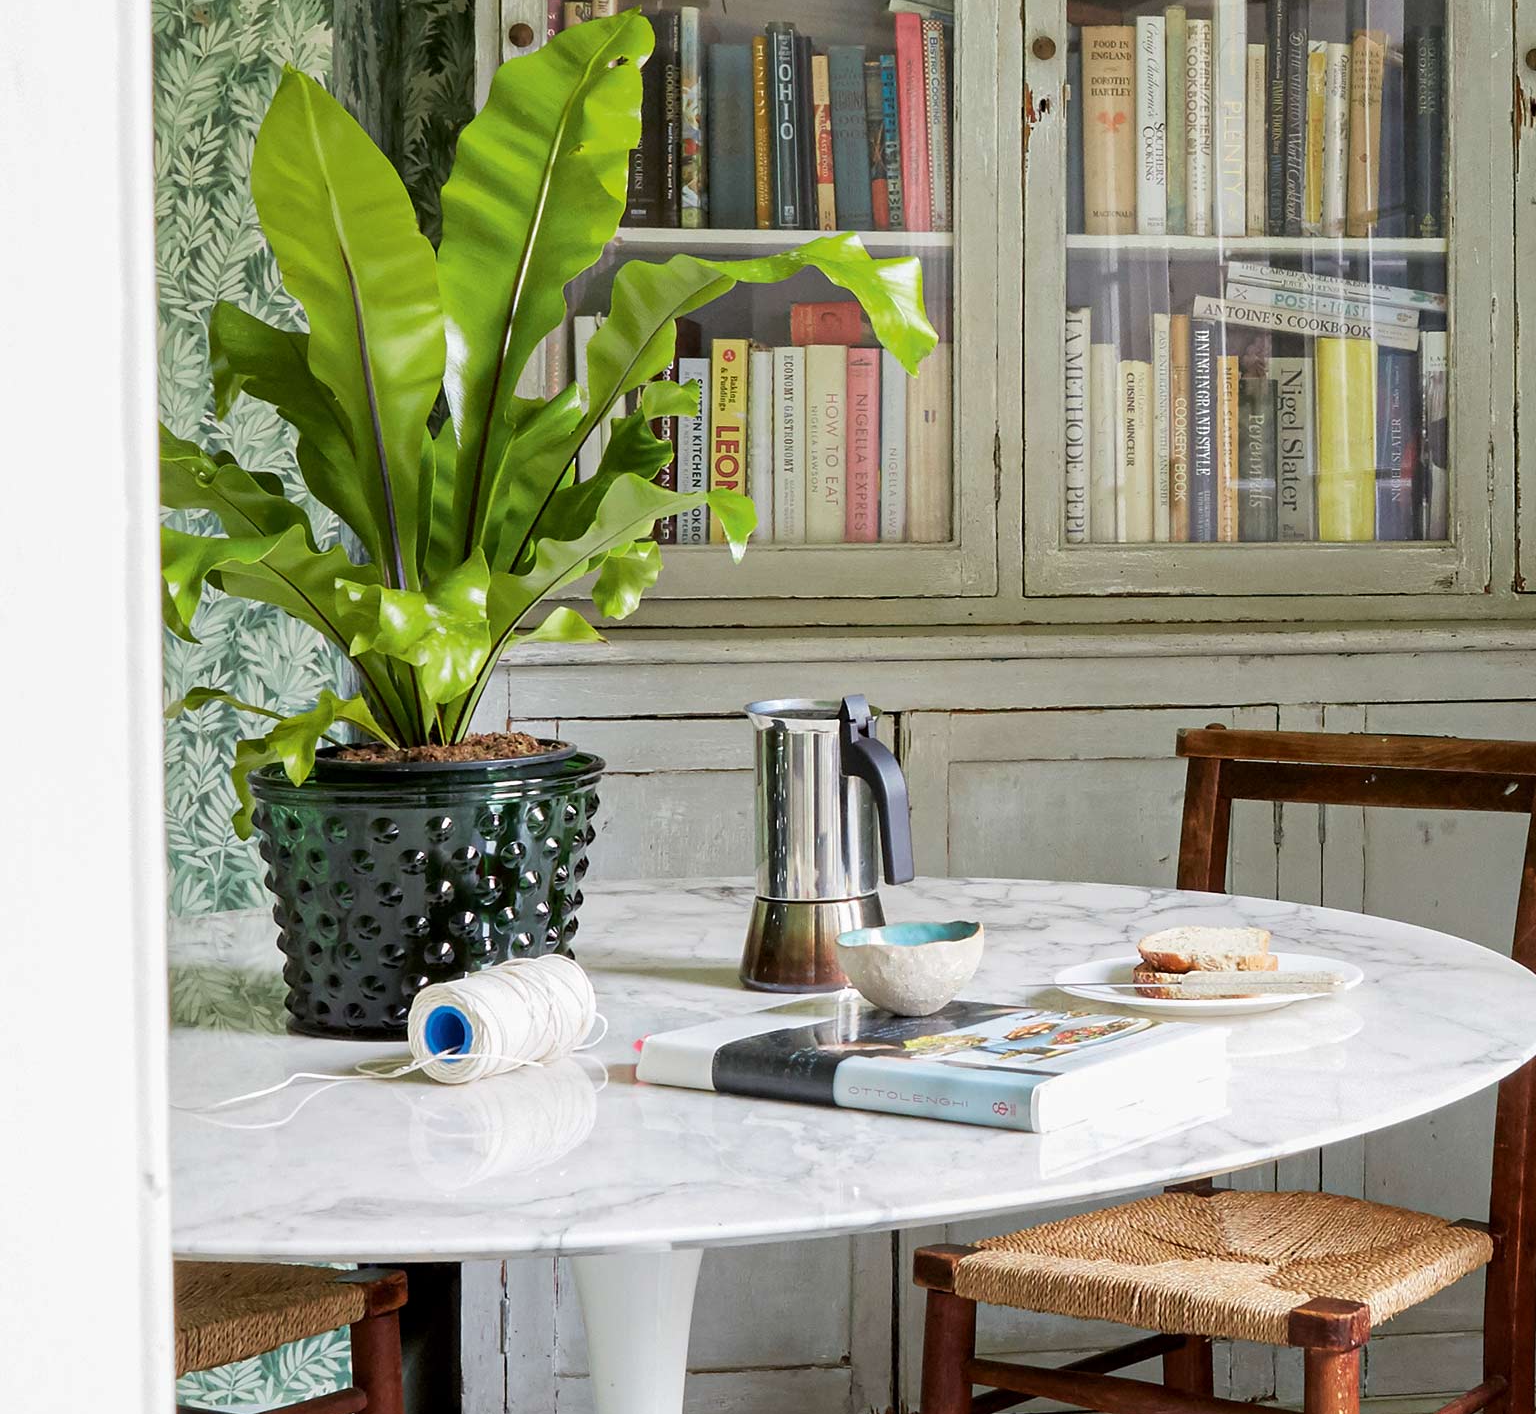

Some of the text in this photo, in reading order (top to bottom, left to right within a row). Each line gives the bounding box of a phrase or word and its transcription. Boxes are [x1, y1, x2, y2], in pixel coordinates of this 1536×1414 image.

[1091, 52, 1132, 61] ENGLAND
[1093, 40, 1129, 49] FOOD IN
[1142, 21, 1160, 119] Craig Claiborne's
[664, 64, 674, 121] COOKBOOK
[778, 64, 794, 139] OHIO
[929, 36, 941, 125] BISTRO COOKING
[1091, 76, 1131, 85] DOROTHY
[1091, 88, 1132, 97] HARTLEY
[1187, 46, 1197, 133] COOKBOOK
[1142, 125, 1154, 181] COOKING
[1153, 122, 1166, 186] SOUTHERN
[1200, 115, 1210, 155] MENU
[1223, 100, 1243, 197] PLENTY
[634, 153, 643, 191] COURSE
[821, 154, 829, 177] FOOD
[1286, 132, 1303, 221] World Cookbook
[1203, 302, 1373, 339] ANTOINE'S COOKBOOK
[1274, 292, 1319, 310] POSH
[783, 355, 794, 402] ECONOMY
[1194, 330, 1211, 374] DINING
[718, 375, 729, 412] Puddings
[728, 375, 738, 404] Baking
[1194, 375, 1211, 390] IN
[783, 405, 794, 473] GASTRONOMY
[855, 393, 869, 464] NIGELLA
[1066, 352, 1083, 475] METHODE
[1125, 372, 1136, 467] CUISINE MINCEUR
[1158, 353, 1168, 507] ENTERTAINING WITH JANE ASHER
[1194, 390, 1211, 436] GRAND
[1223, 367, 1233, 468] NIGEL SLATER'S
[1277, 368, 1304, 512] Nigel Slater
[692, 435, 703, 488] KITCHEN
[810, 405, 818, 493] NIGELLA LAWSON
[825, 393, 839, 506] HOW TO EAT
[888, 447, 898, 497] NIGELLA
[1174, 397, 1187, 502] COOKERY BOOK
[1194, 436, 1211, 477] STYLE
[1249, 413, 1273, 508] Perennials
[1391, 418, 1402, 502] NIGEL SLATER
[848, 1086, 969, 1108] OTTOLENGHI
